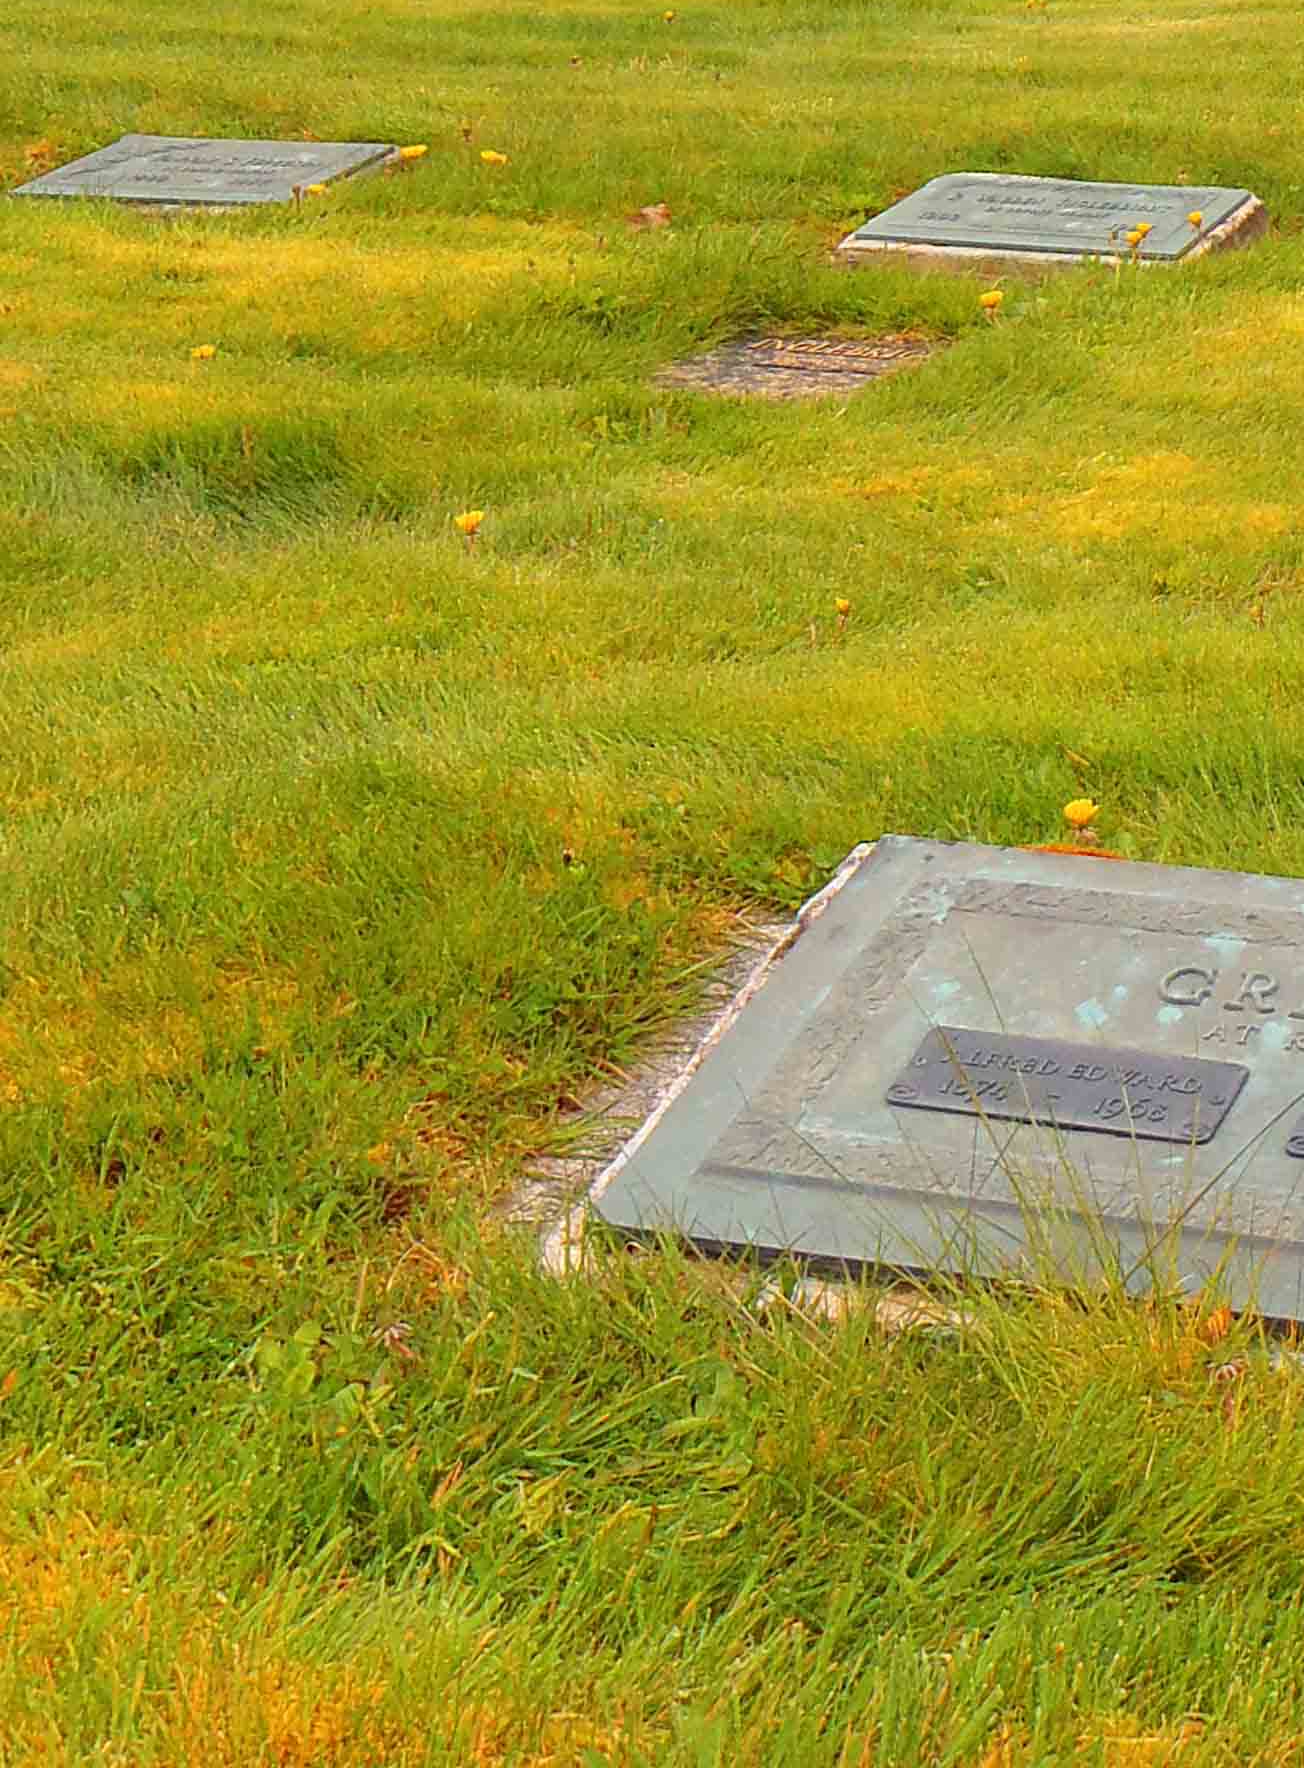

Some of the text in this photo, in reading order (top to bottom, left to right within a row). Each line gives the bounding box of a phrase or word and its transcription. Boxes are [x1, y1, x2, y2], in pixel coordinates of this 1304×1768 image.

[1200, 1023, 1261, 1046] AT
[940, 1047, 1202, 1095] ALFRED EDWARD
